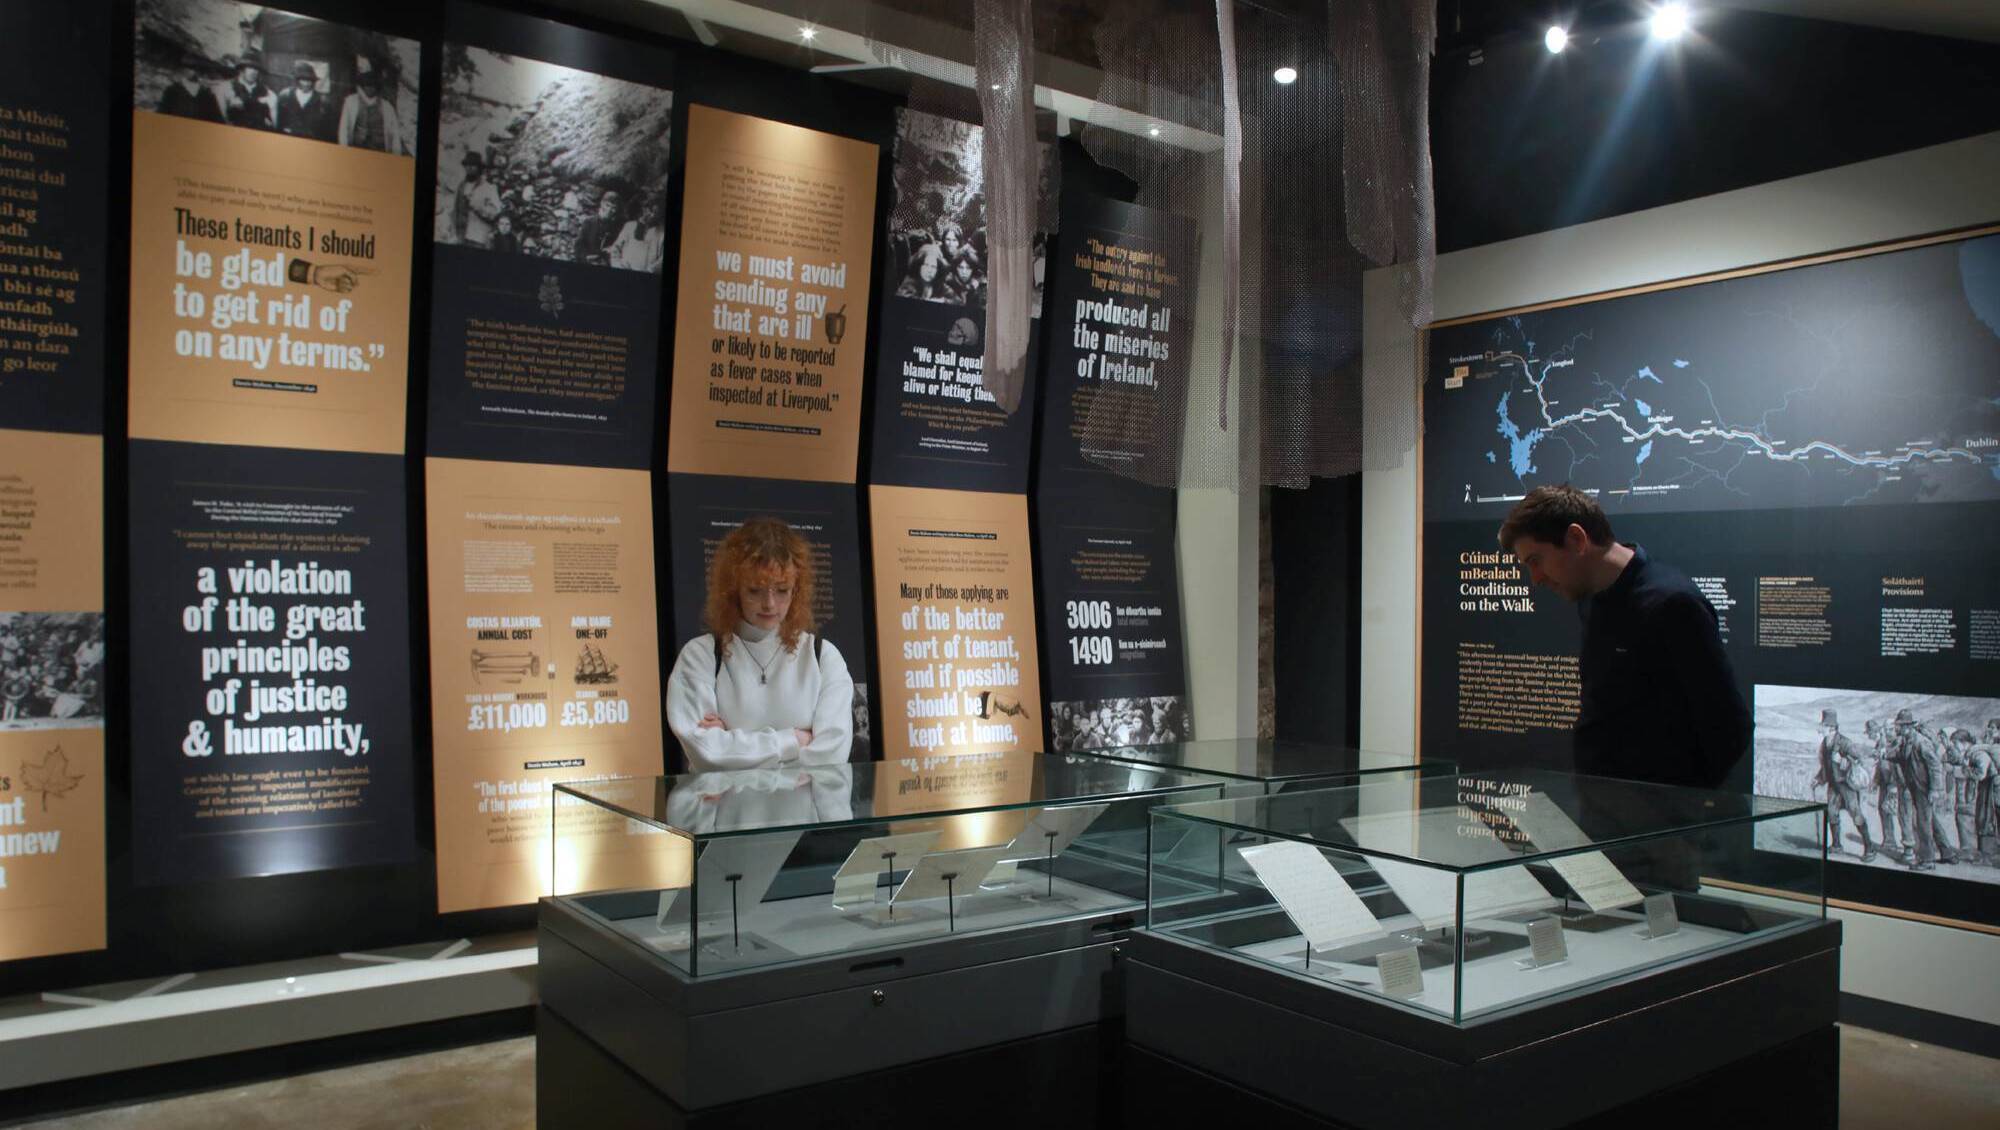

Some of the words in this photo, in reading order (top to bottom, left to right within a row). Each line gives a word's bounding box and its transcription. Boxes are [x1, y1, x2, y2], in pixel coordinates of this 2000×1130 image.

[174, 207, 228, 240] These
[235, 217, 301, 249] tenants
[309, 226, 315, 251] I
[321, 228, 375, 260] should
[176, 239, 212, 279] be
[221, 247, 285, 290] glad
[716, 249, 741, 273] we
[748, 255, 794, 281] must
[801, 261, 847, 289] avoid
[173, 282, 205, 318] to
[211, 290, 260, 329] get
[267, 293, 311, 330] rid
[320, 299, 353, 333] of
[715, 278, 788, 314] sending
[795, 291, 827, 320] any
[713, 303, 752, 334] that
[758, 314, 789, 338] are
[795, 314, 811, 340] ill
[1076, 297, 1148, 329] produced
[1152, 306, 1171, 332] all
[175, 329, 212, 358] on
[219, 332, 273, 370] any
[711, 337, 724, 354] or
[728, 335, 756, 360] likely
[760, 340, 771, 359] to
[774, 341, 787, 361] be
[791, 347, 835, 366] reported
[1073, 322, 1099, 350] the
[1104, 330, 1169, 360] miseries
[4, 357, 25, 372] go
[27, 356, 58, 372] leor
[711, 361, 724, 378] as
[728, 359, 756, 380] fever
[760, 366, 792, 385] cases
[795, 367, 822, 387] when
[903, 361, 936, 379] blamed
[939, 366, 953, 381] for
[956, 368, 983, 387] keepin
[935, 350, 957, 366] shall
[959, 355, 984, 371] equal
[1077, 352, 1097, 379] of
[1100, 354, 1158, 391] Ireland,
[709, 382, 763, 406] inspected
[766, 389, 778, 407] at
[903, 378, 926, 395] alive
[928, 383, 940, 396] or
[941, 382, 973, 403] letting
[1966, 438, 1999, 449] Dublin
[1460, 550, 1500, 564] Cúinsí
[1501, 552, 1516, 564] ar
[197, 566, 217, 594] a
[227, 559, 352, 594] violation
[1460, 566, 1520, 580] mBealach
[900, 582, 922, 601] Many
[925, 582, 934, 599] of
[936, 583, 958, 599] those
[960, 585, 994, 603] applying
[996, 588, 1009, 600] are
[1460, 582, 1529, 596] Conditions
[1882, 587, 1925, 596] Provisions
[183, 597, 219, 632] of
[225, 597, 275, 632] the
[286, 600, 366, 639] great
[901, 605, 920, 631] of
[924, 605, 950, 631] the
[955, 606, 1004, 631] better
[1065, 600, 1112, 630] 3006
[1460, 600, 1476, 612] on
[1480, 598, 1499, 611] the
[1501, 599, 1535, 612] Walk
[478, 629, 509, 640] ANNUAL
[512, 629, 533, 640] COST
[576, 628, 608, 640] ONE-OFF
[903, 636, 939, 660] sort
[943, 634, 961, 659] of
[964, 635, 1020, 661] tenant,
[203, 638, 351, 681] principles
[1068, 635, 1113, 665] 1490
[905, 663, 935, 689] and
[938, 662, 953, 688] if
[956, 662, 1019, 692] possible
[206, 678, 241, 716] of
[243, 679, 348, 722] justice
[560, 699, 629, 729] £5,860
[906, 691, 958, 718] should
[964, 690, 982, 716] be
[467, 702, 547, 733] £11,000
[182, 720, 214, 758] &
[224, 717, 370, 757] humanity,
[908, 722, 945, 752] kept
[950, 721, 968, 746] at
[972, 720, 1019, 745] home,
